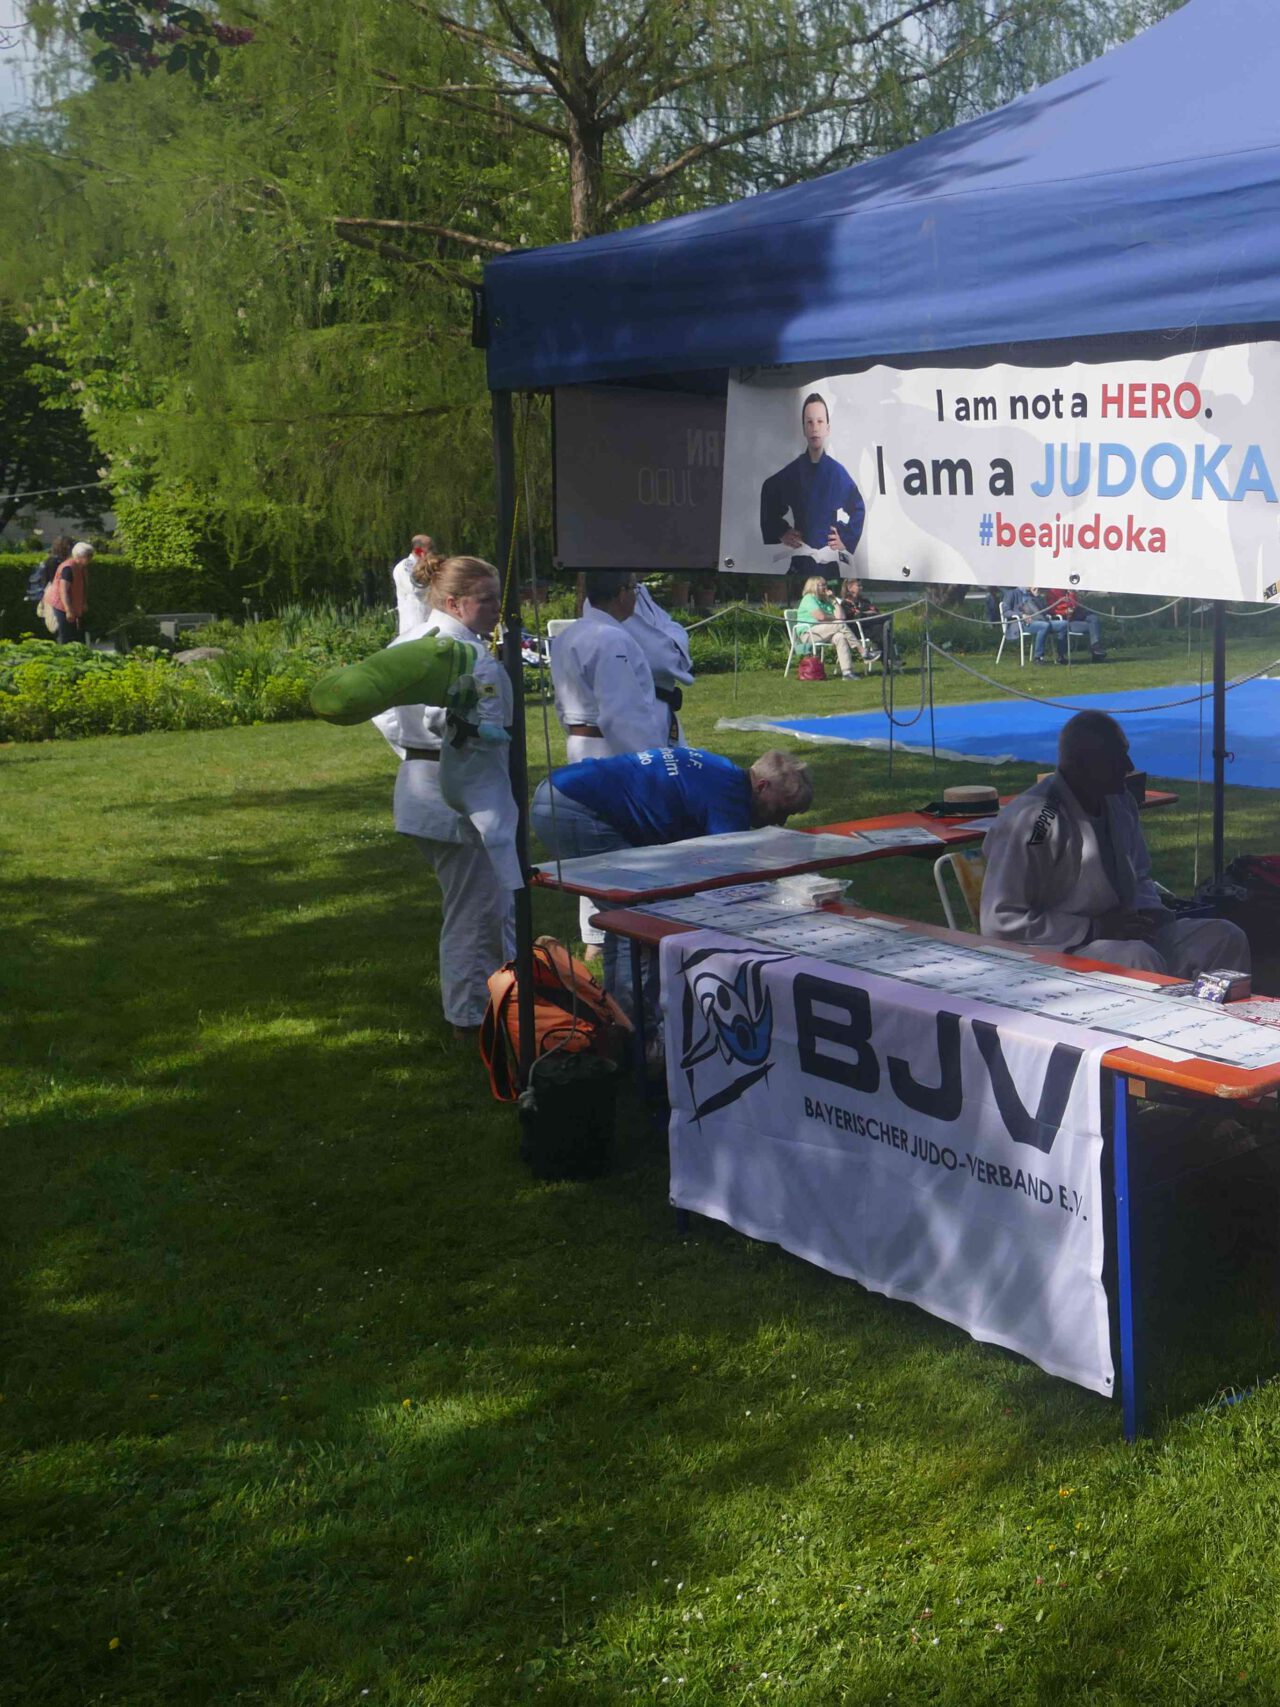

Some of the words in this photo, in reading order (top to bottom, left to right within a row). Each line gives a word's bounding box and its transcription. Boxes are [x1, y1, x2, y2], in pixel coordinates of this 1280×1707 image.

[936, 389, 945, 422] I
[954, 395, 998, 422] am
[1009, 388, 1064, 420] not
[1070, 392, 1088, 419] a
[1100, 382, 1214, 420] HERO.
[876, 445, 887, 495] I
[903, 457, 974, 496] am
[989, 457, 1015, 497] a
[978, 511, 1168, 559] #beajudoka
[793, 971, 1086, 1155] BJV
[803, 1095, 911, 1163] BAYERISCHER
[910, 1135, 1054, 1206] JUDO-VERBAND
[1057, 1183, 1089, 1222] E.V.
